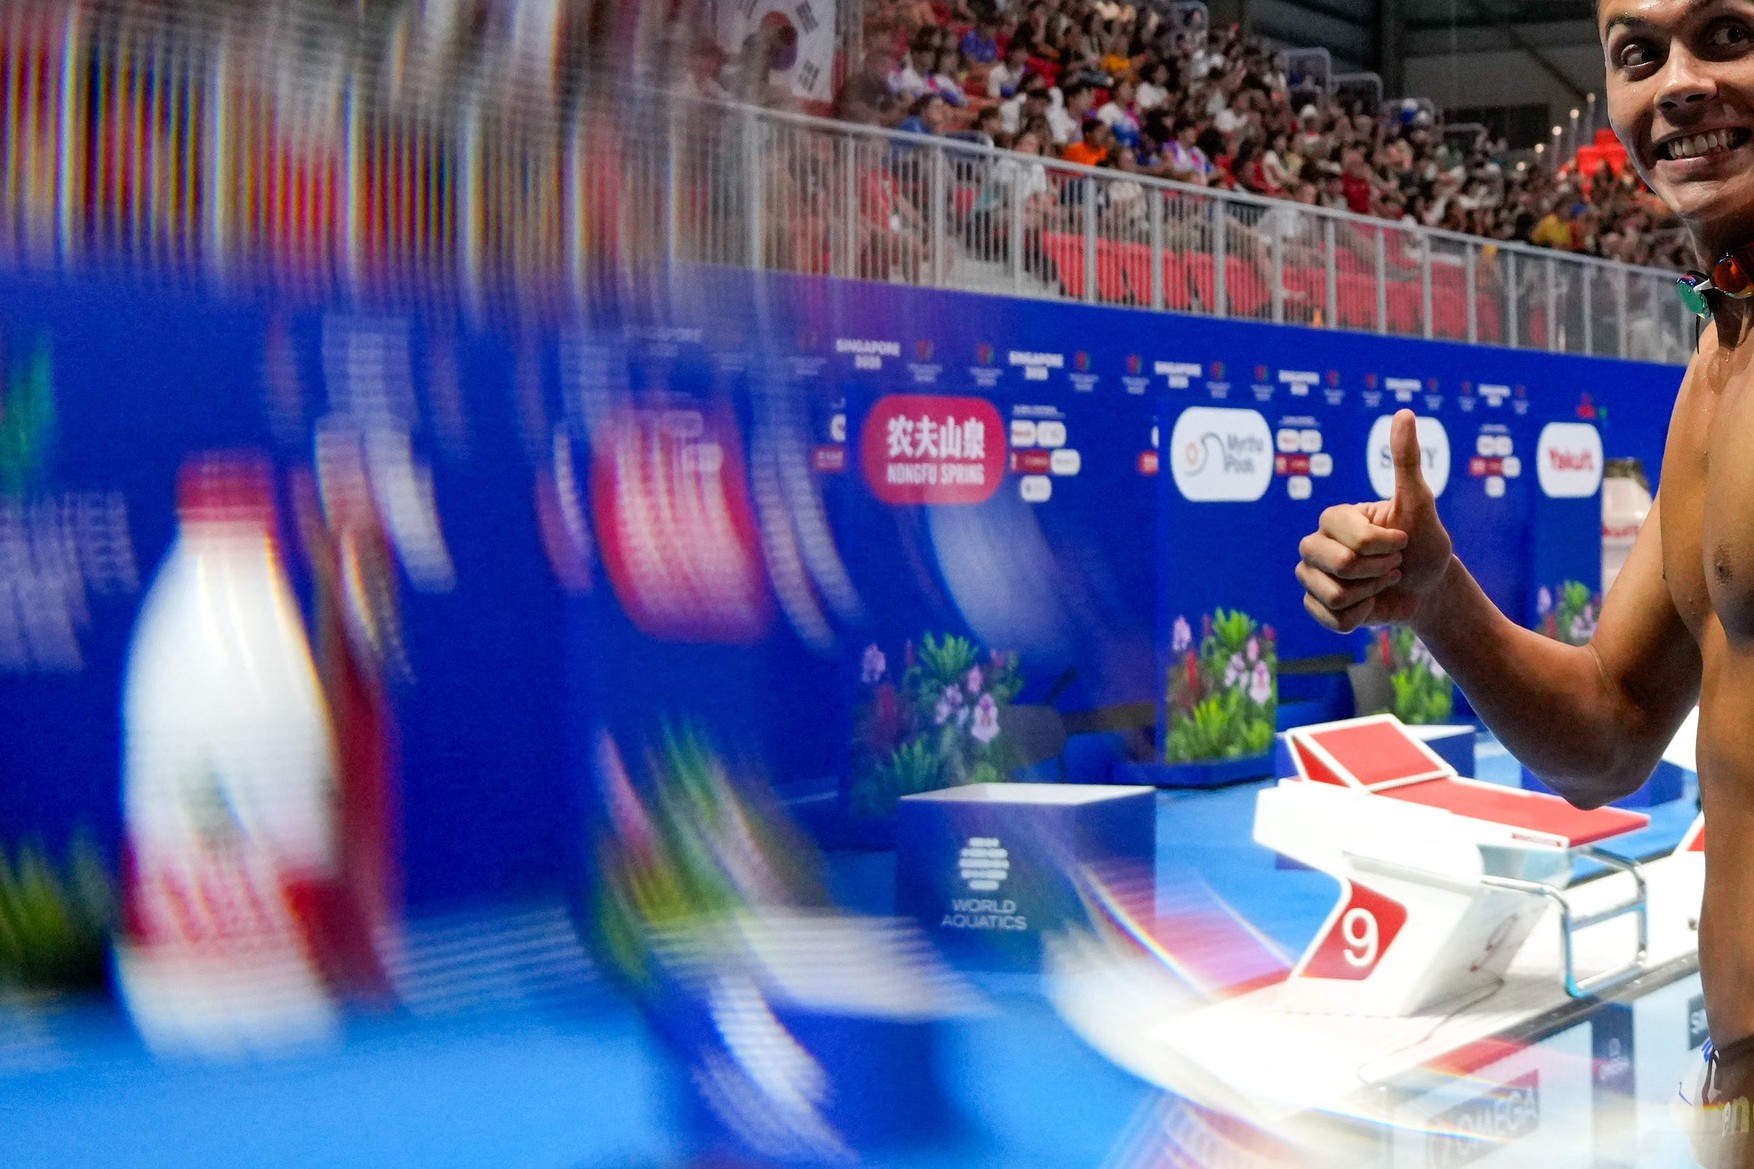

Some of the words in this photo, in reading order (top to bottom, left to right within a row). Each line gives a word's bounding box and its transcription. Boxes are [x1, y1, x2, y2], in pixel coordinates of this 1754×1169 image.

[887, 414, 985, 459] 农夫山泉
[1380, 449, 1437, 469] SY
[887, 463, 938, 484] NONGFU
[941, 463, 985, 485] SPRING
[952, 899, 1016, 914] WORLD
[941, 915, 1027, 930] AQUATICS
[1342, 908, 1379, 967] 9
